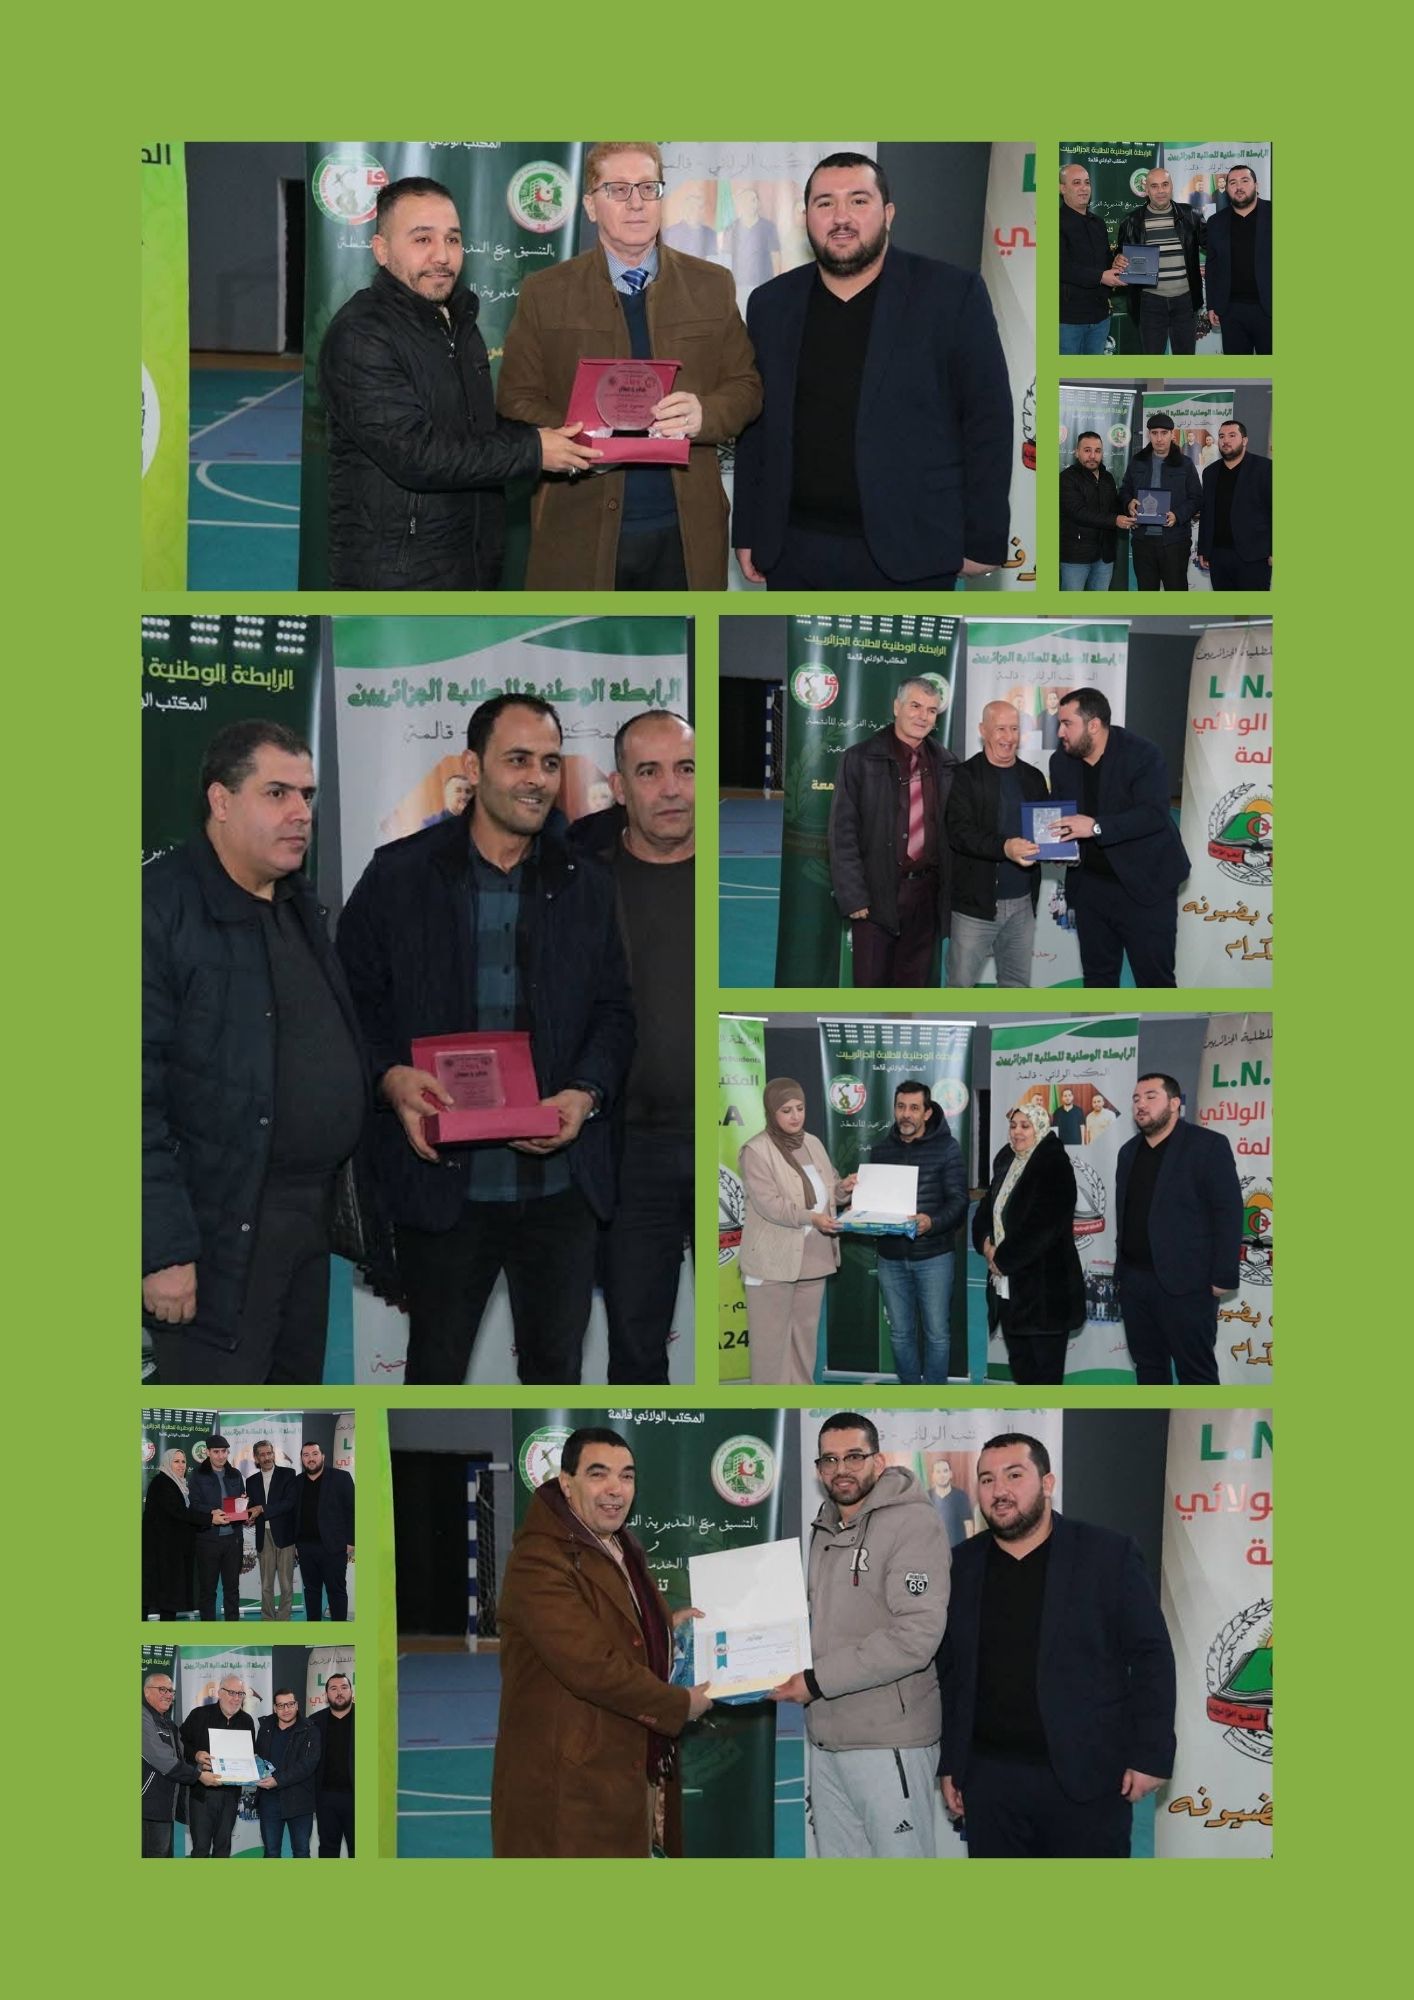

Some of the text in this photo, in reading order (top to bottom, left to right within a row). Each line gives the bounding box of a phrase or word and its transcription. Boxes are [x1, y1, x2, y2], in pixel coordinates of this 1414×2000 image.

[149, 657, 295, 692] الرابطة الوطنية
[155, 695, 207, 712] المكتب
[1235, 746, 1272, 764] لمة
[1212, 1060, 1271, 1088] L.N.
[1199, 1101, 1265, 1126] الولائي
[1236, 1136, 1270, 1156] لمة
[719, 1330, 749, 1350] 24
[608, 1408, 705, 1425] المكتب الولائي قالمة
[645, 1515, 695, 1535] المديرية
[699, 1518, 715, 1535] مع
[719, 1516, 759, 1532] بالتنسيق
[647, 1540, 660, 1552] و
[909, 1580, 925, 1593] 69
